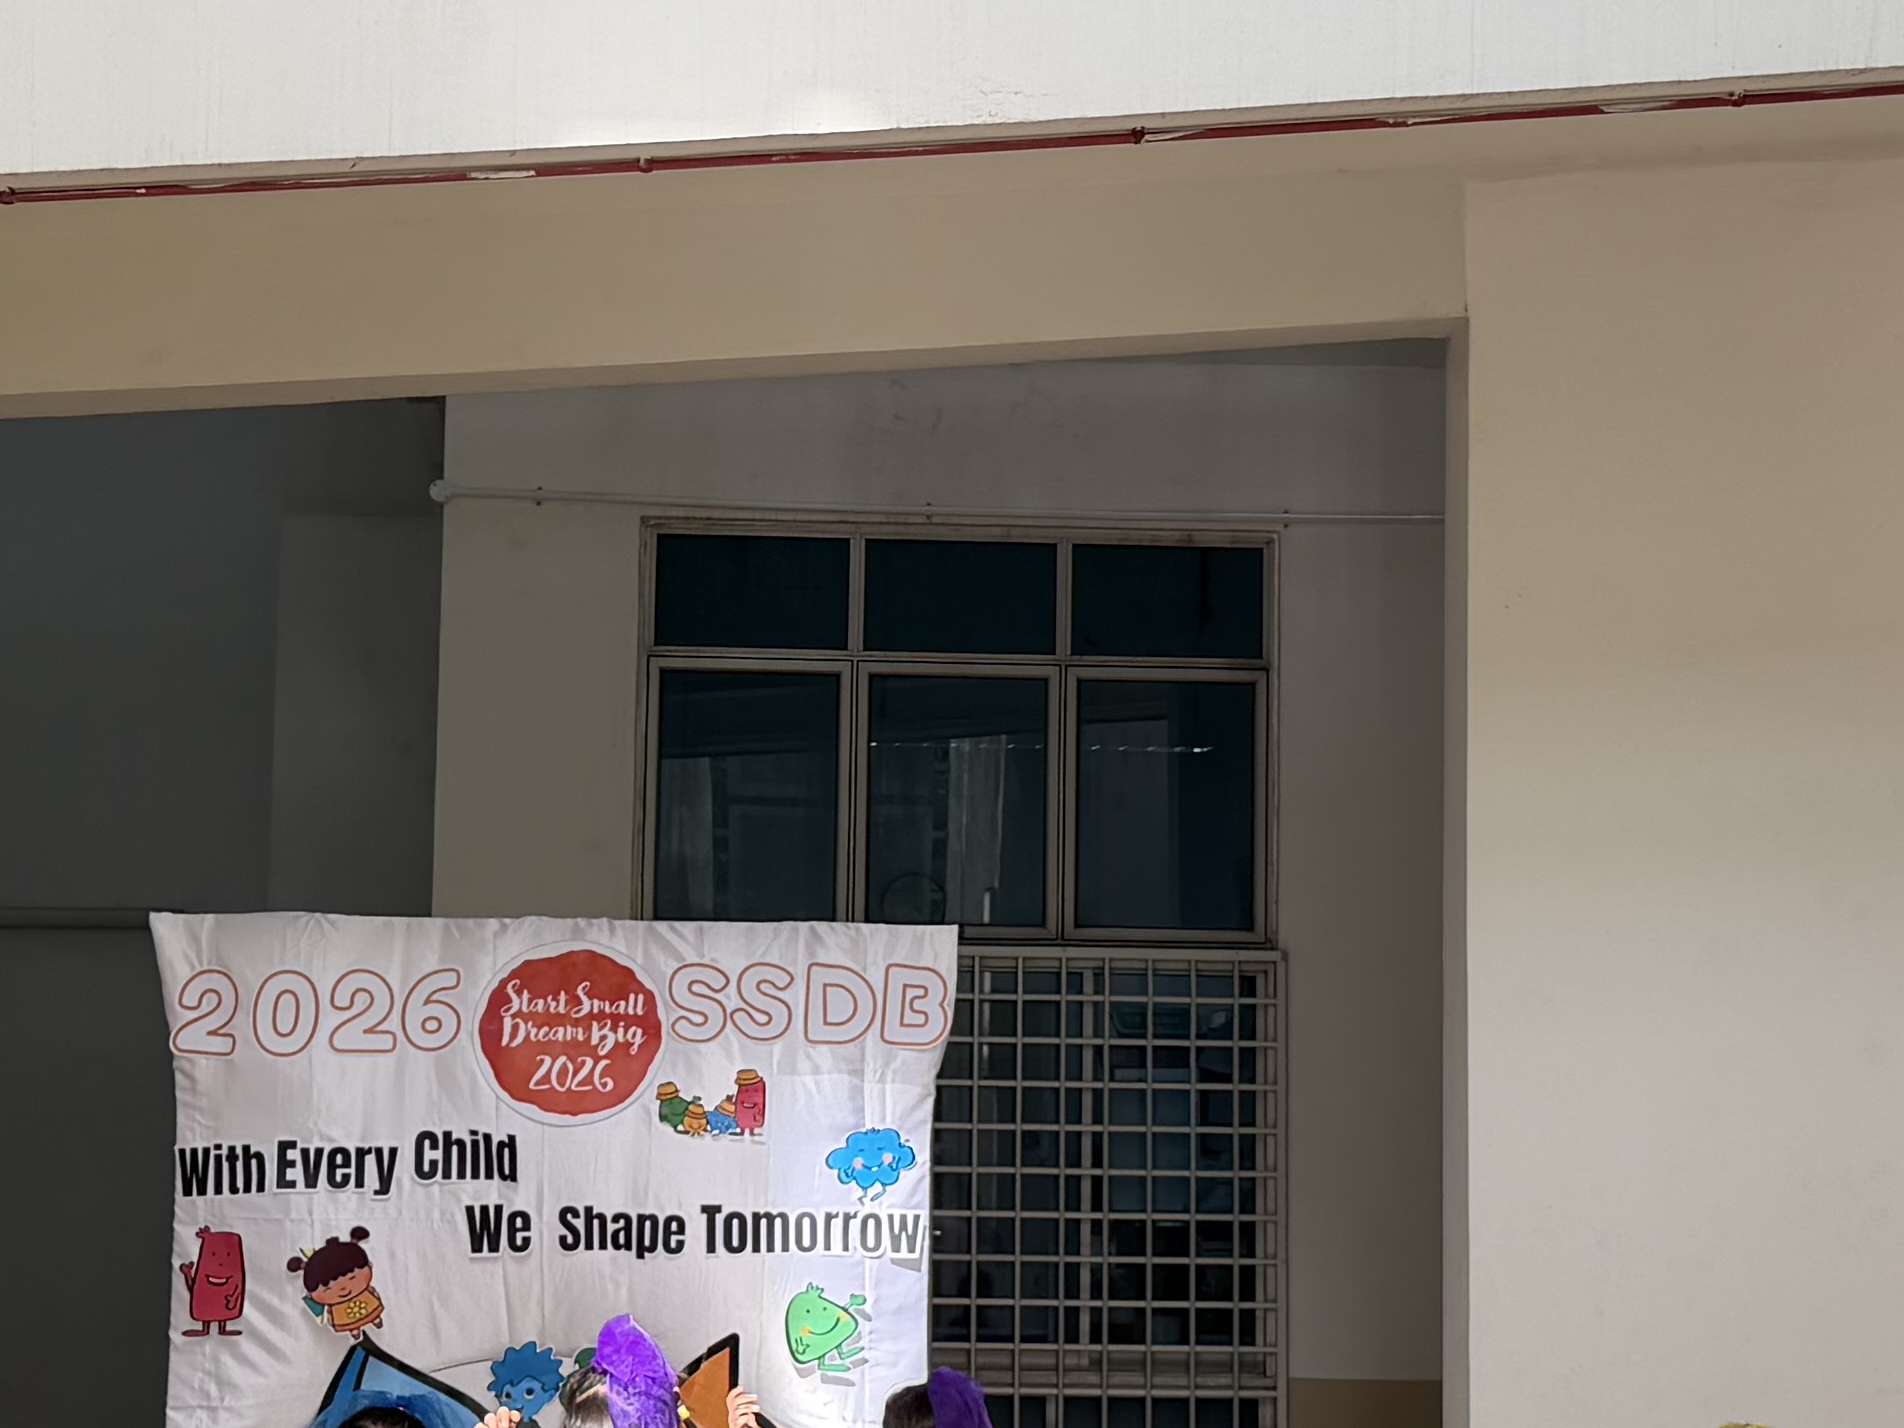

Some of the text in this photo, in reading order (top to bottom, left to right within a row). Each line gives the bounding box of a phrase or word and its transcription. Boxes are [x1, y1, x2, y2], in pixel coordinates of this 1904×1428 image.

[172, 968, 462, 1057] 2026
[500, 979, 647, 1018] Start Small
[668, 962, 948, 1046] SSDB
[500, 1016, 647, 1056] Dream Big
[528, 1054, 615, 1093] 2026
[177, 1130, 519, 1197] With Every Child
[465, 1203, 923, 1259] We Shape Tomorrow
